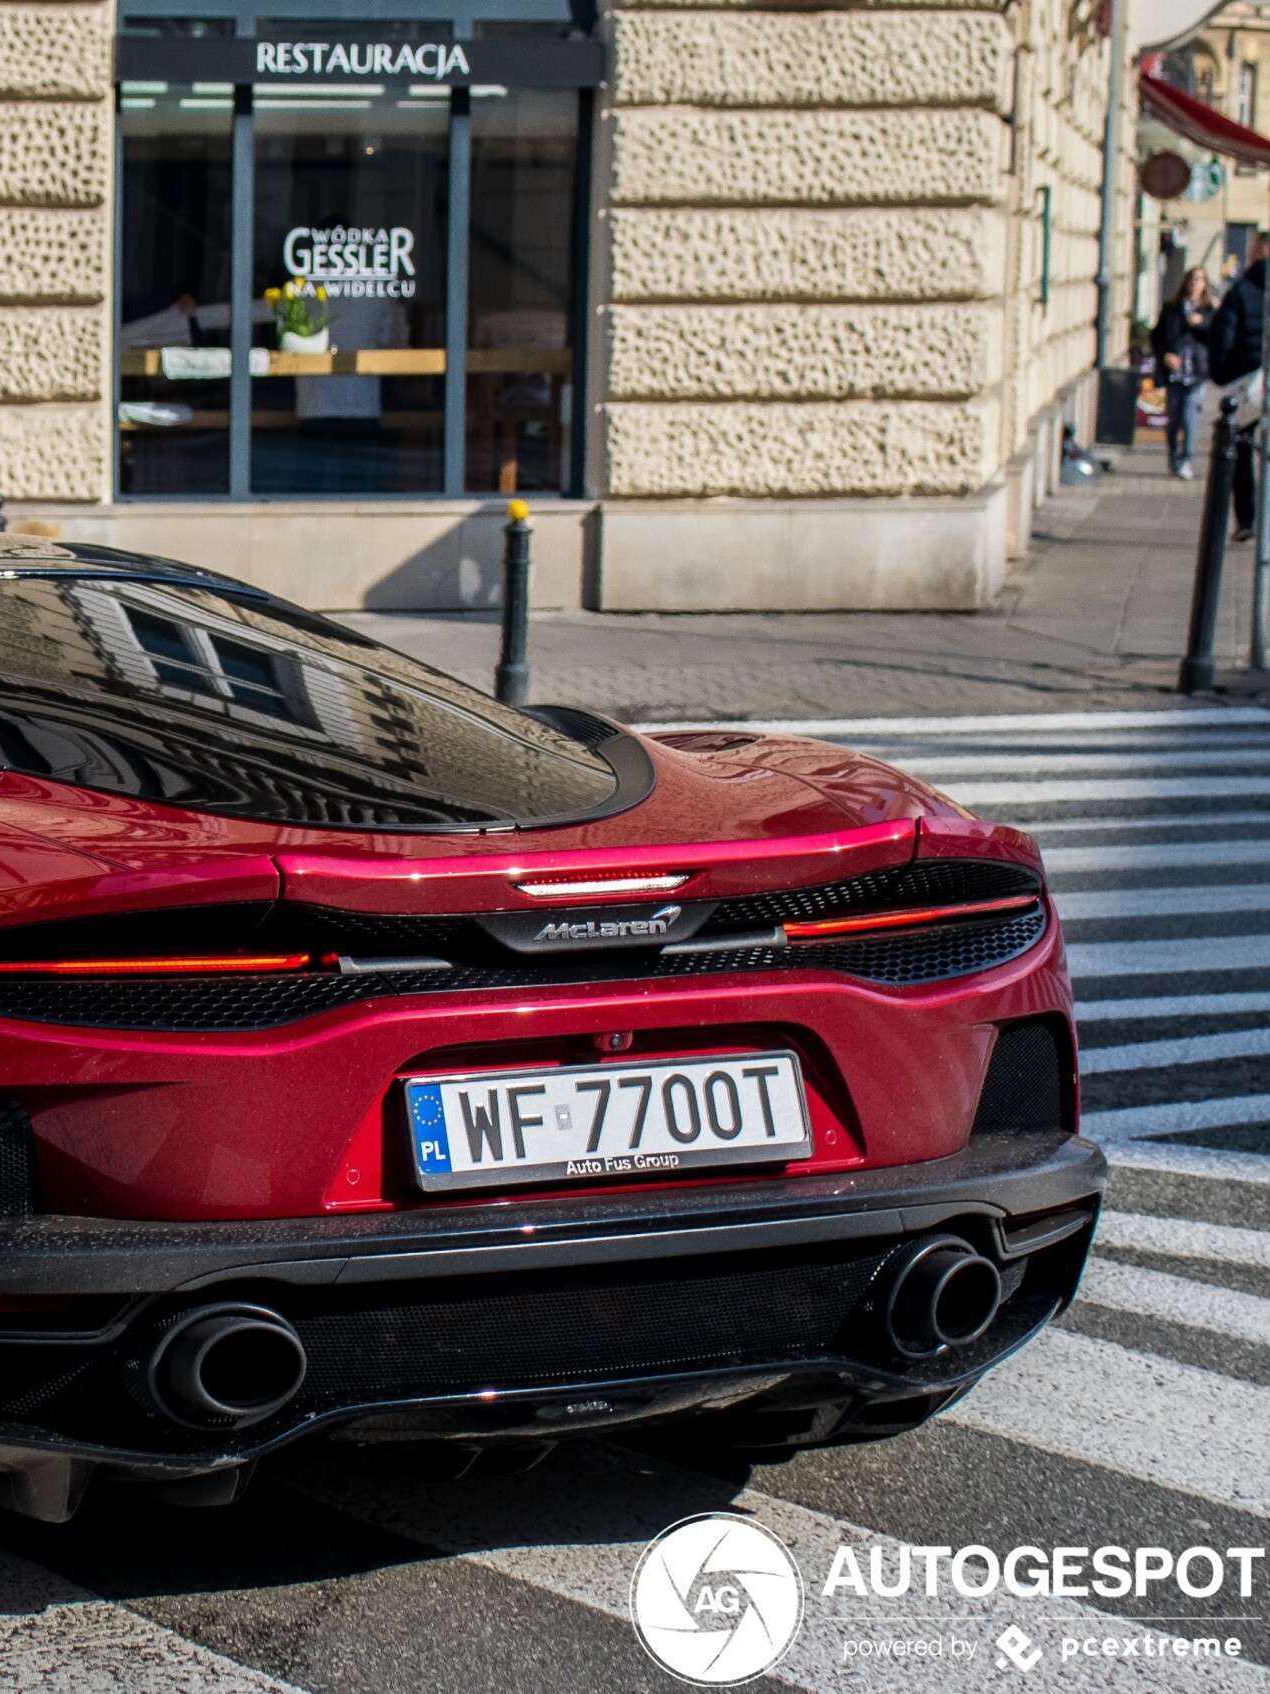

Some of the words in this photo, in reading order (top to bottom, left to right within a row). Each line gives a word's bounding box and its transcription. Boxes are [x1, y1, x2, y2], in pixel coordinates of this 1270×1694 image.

[256, 42, 470, 80] RESTAURACJA
[311, 224, 389, 245] WÓDKA
[283, 226, 416, 276] GESSLER
[323, 280, 416, 298] WIDELCU
[533, 919, 667, 941] McLaren
[458, 1082, 546, 1163] WF
[575, 1065, 780, 1153] 7700T
[421, 1141, 446, 1162] PL
[566, 1158, 601, 1175] Auto
[605, 1156, 631, 1171] Fus
[634, 1154, 679, 1171] Group
